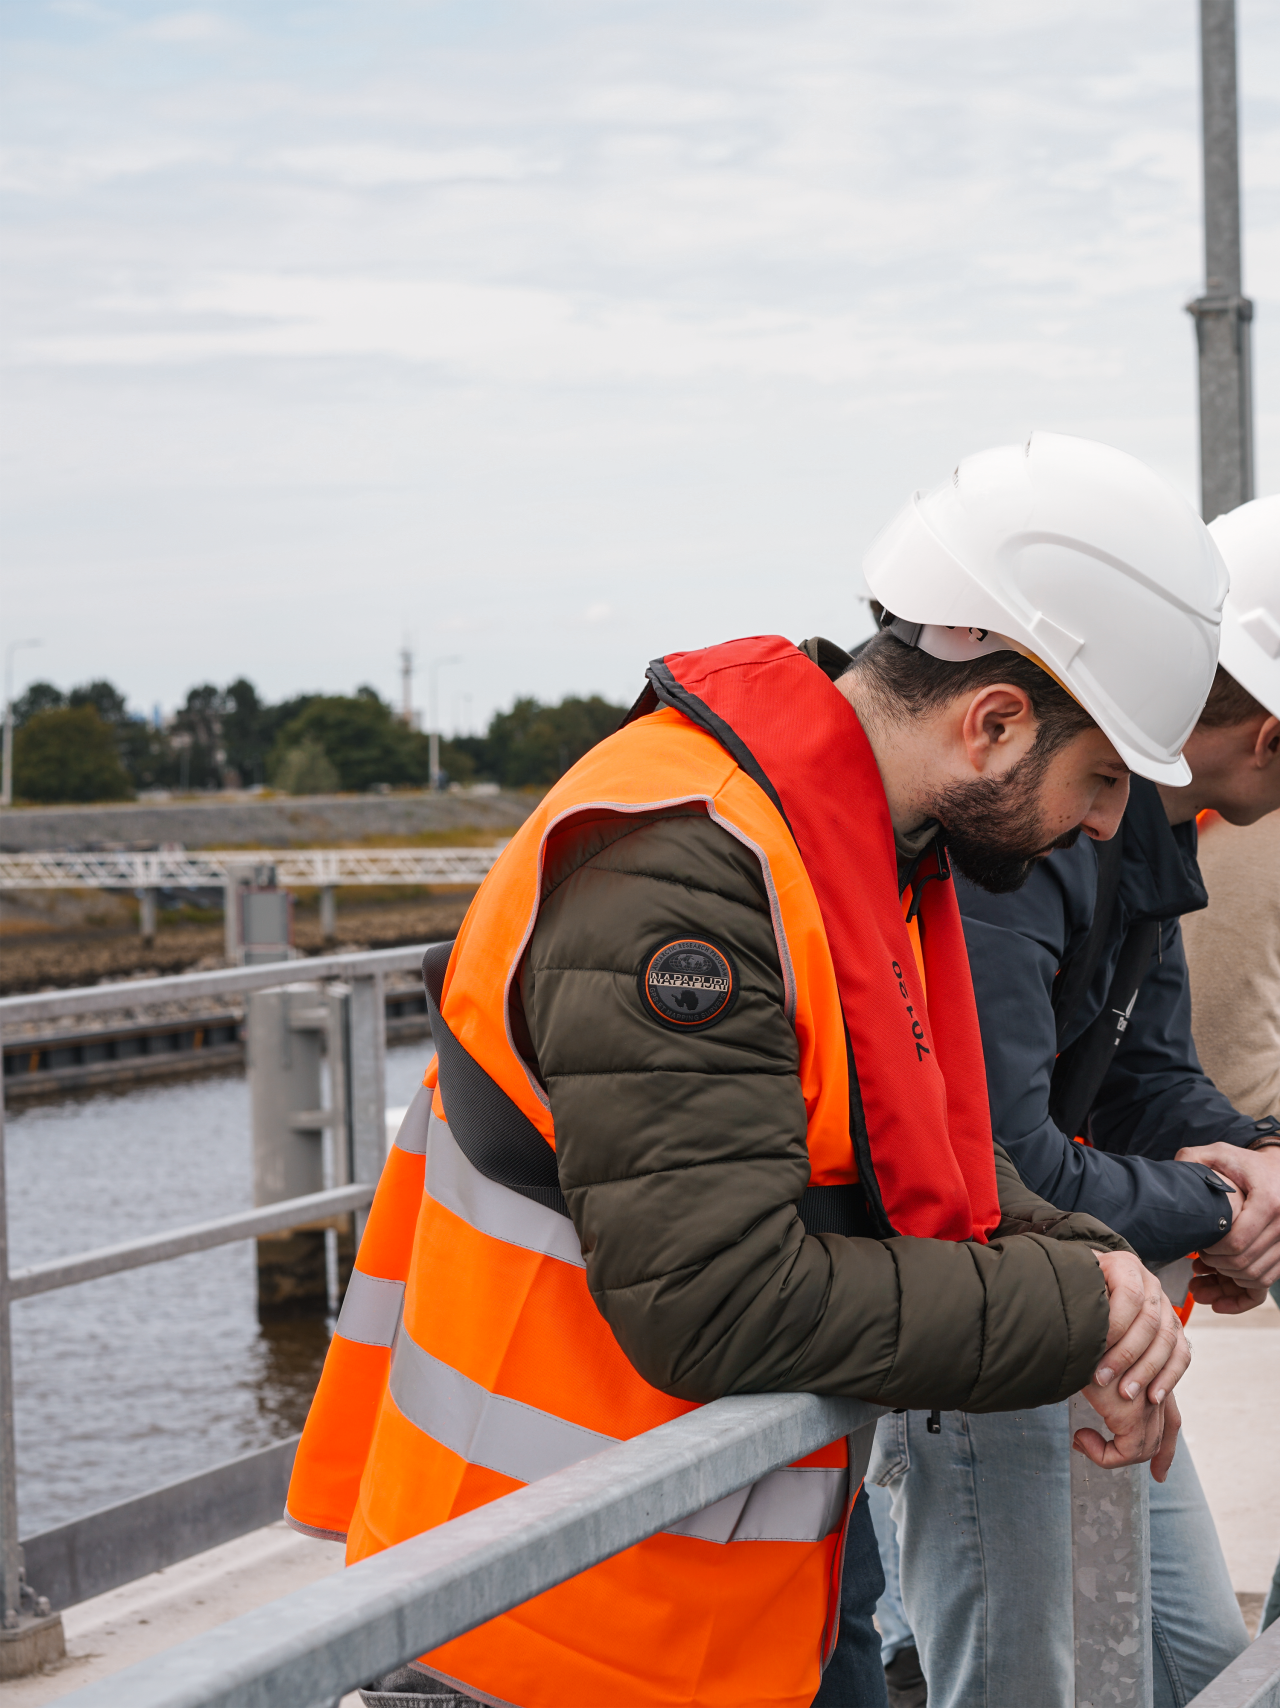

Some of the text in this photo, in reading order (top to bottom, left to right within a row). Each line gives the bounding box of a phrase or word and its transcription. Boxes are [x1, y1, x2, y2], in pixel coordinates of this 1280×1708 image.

[652, 942, 728, 977] ANTARCTIC RESEARCH PROGRAM
[651, 972, 727, 990] NAPAPIJRI
[666, 1009, 699, 1021] MAPPING
[701, 992, 726, 1018] SURVEYS
